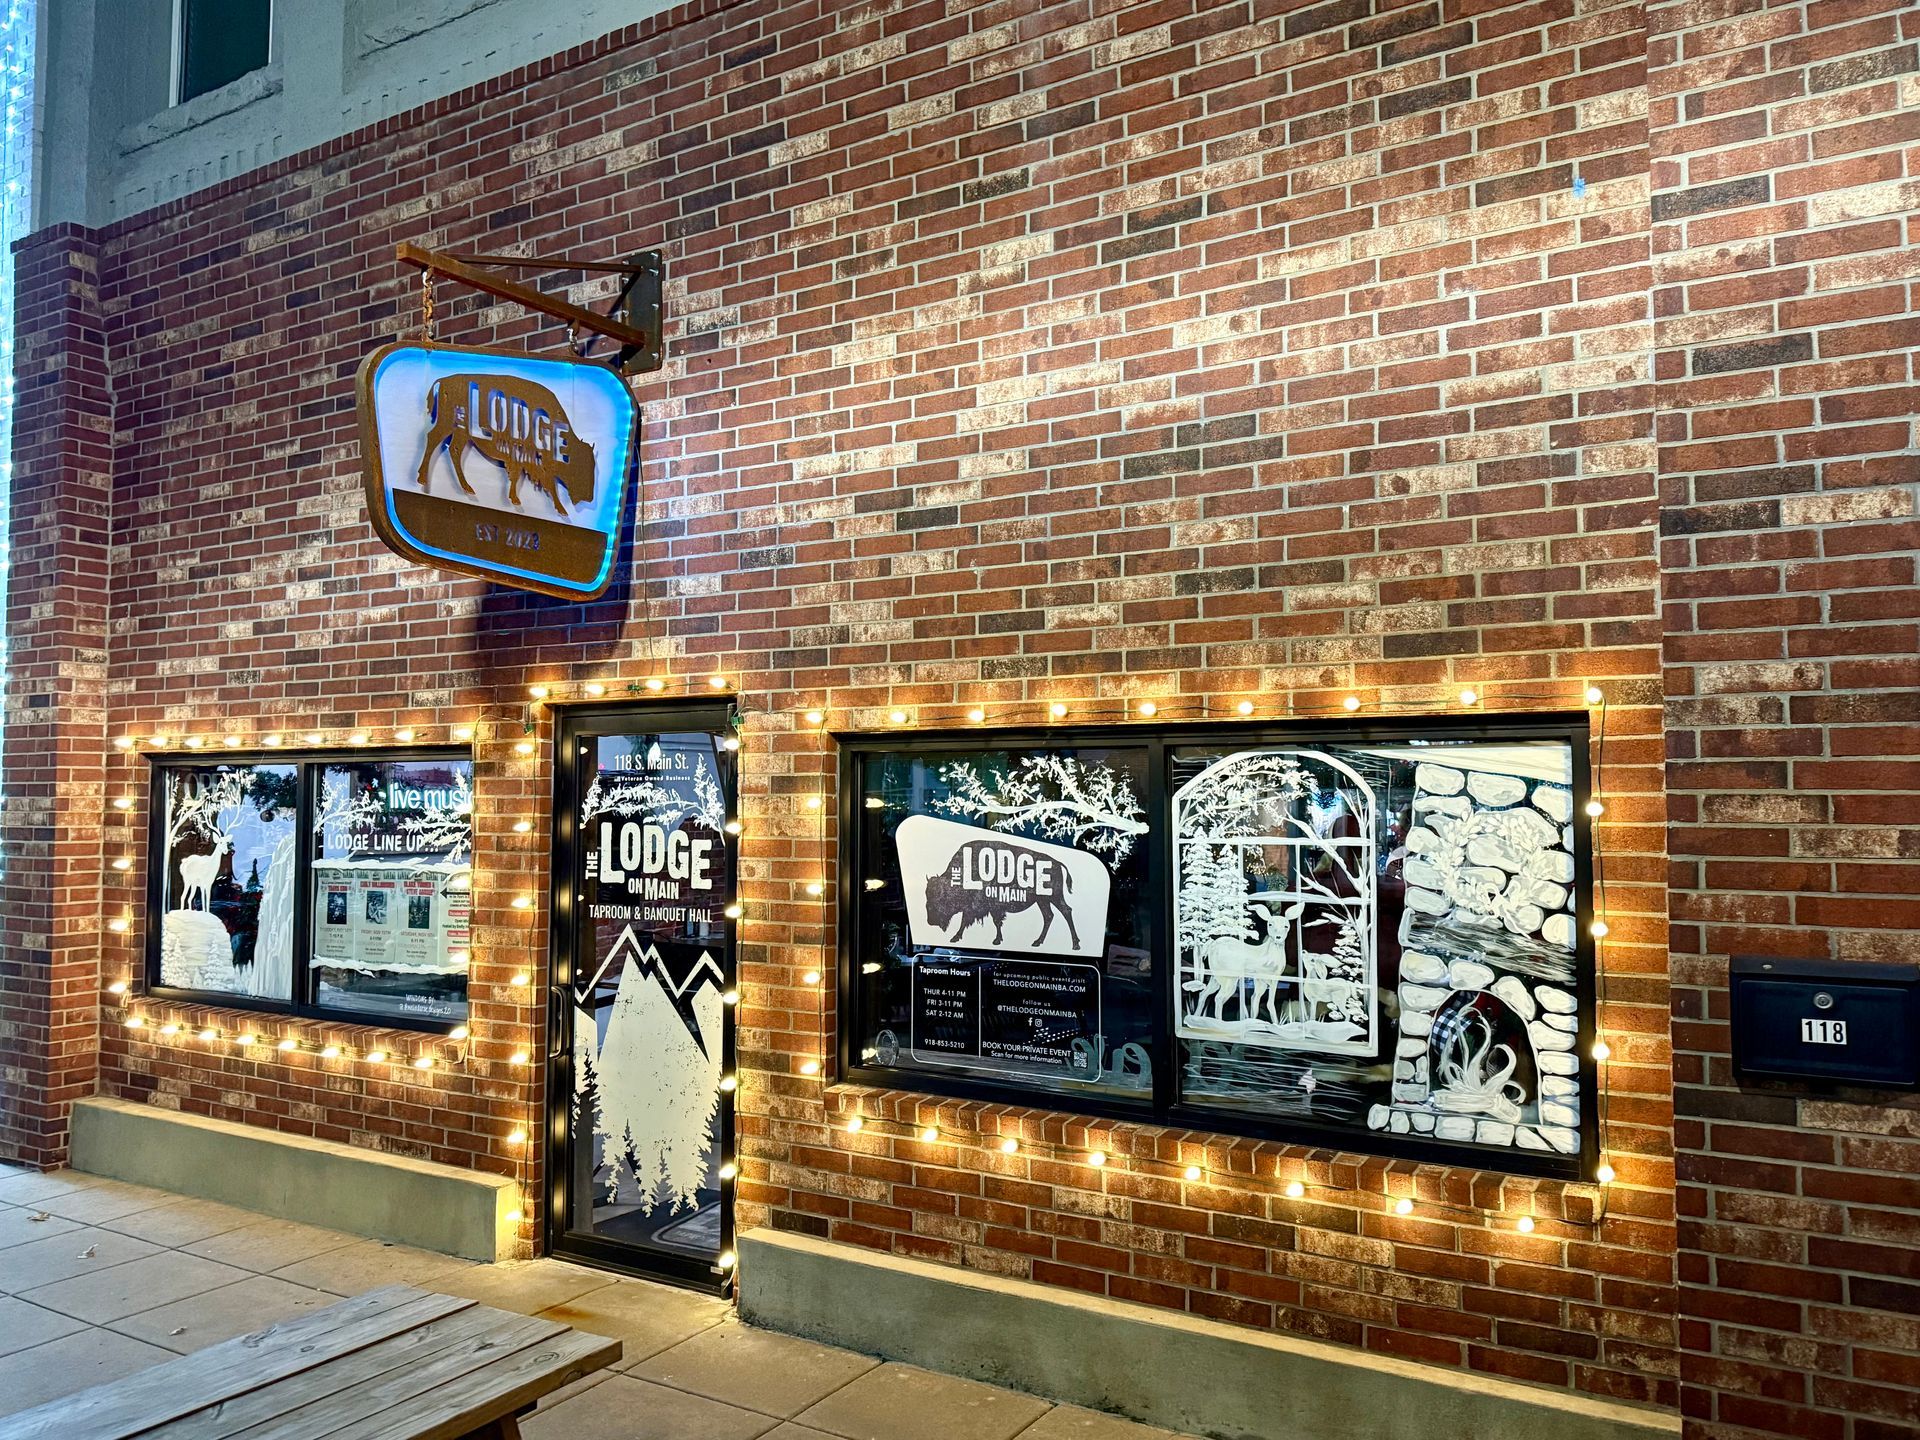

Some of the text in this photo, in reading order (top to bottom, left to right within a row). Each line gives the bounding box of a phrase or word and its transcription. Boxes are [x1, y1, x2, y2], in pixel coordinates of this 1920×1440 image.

[468, 381, 570, 465] LODGE
[475, 522, 499, 544] EST
[614, 753, 689, 770] 118 S. Main St.
[389, 782, 421, 810] live
[327, 834, 369, 851] LODGE
[374, 834, 402, 851] LINE
[584, 822, 713, 890] THE LODGE
[951, 846, 1053, 896] THE LODGE
[628, 878, 679, 901] ON MAIN
[985, 886, 1027, 903] ON MAIN
[589, 904, 713, 923] TAPROOM & BANQUET HALL
[919, 966, 971, 977] Taproom Hours
[1003, 973, 1030, 981] upcoming
[924, 987, 967, 998] THUR 4-11 PM
[993, 978, 1087, 993] THELODGEONMAINBA.COM
[938, 999, 951, 1007] 3-11
[997, 1004, 1078, 1019] @THELODGEONMAINBA
[925, 1008, 964, 1019] SAT 2-12 AM
[1804, 1020, 1844, 1043] 118
[924, 1038, 965, 1049] 918-853-5210
[982, 1040, 1071, 1057] BOOK YOUR PRIVATE EVENT
[1005, 1051, 1013, 1059] for
[1029, 1054, 1062, 1065] information
